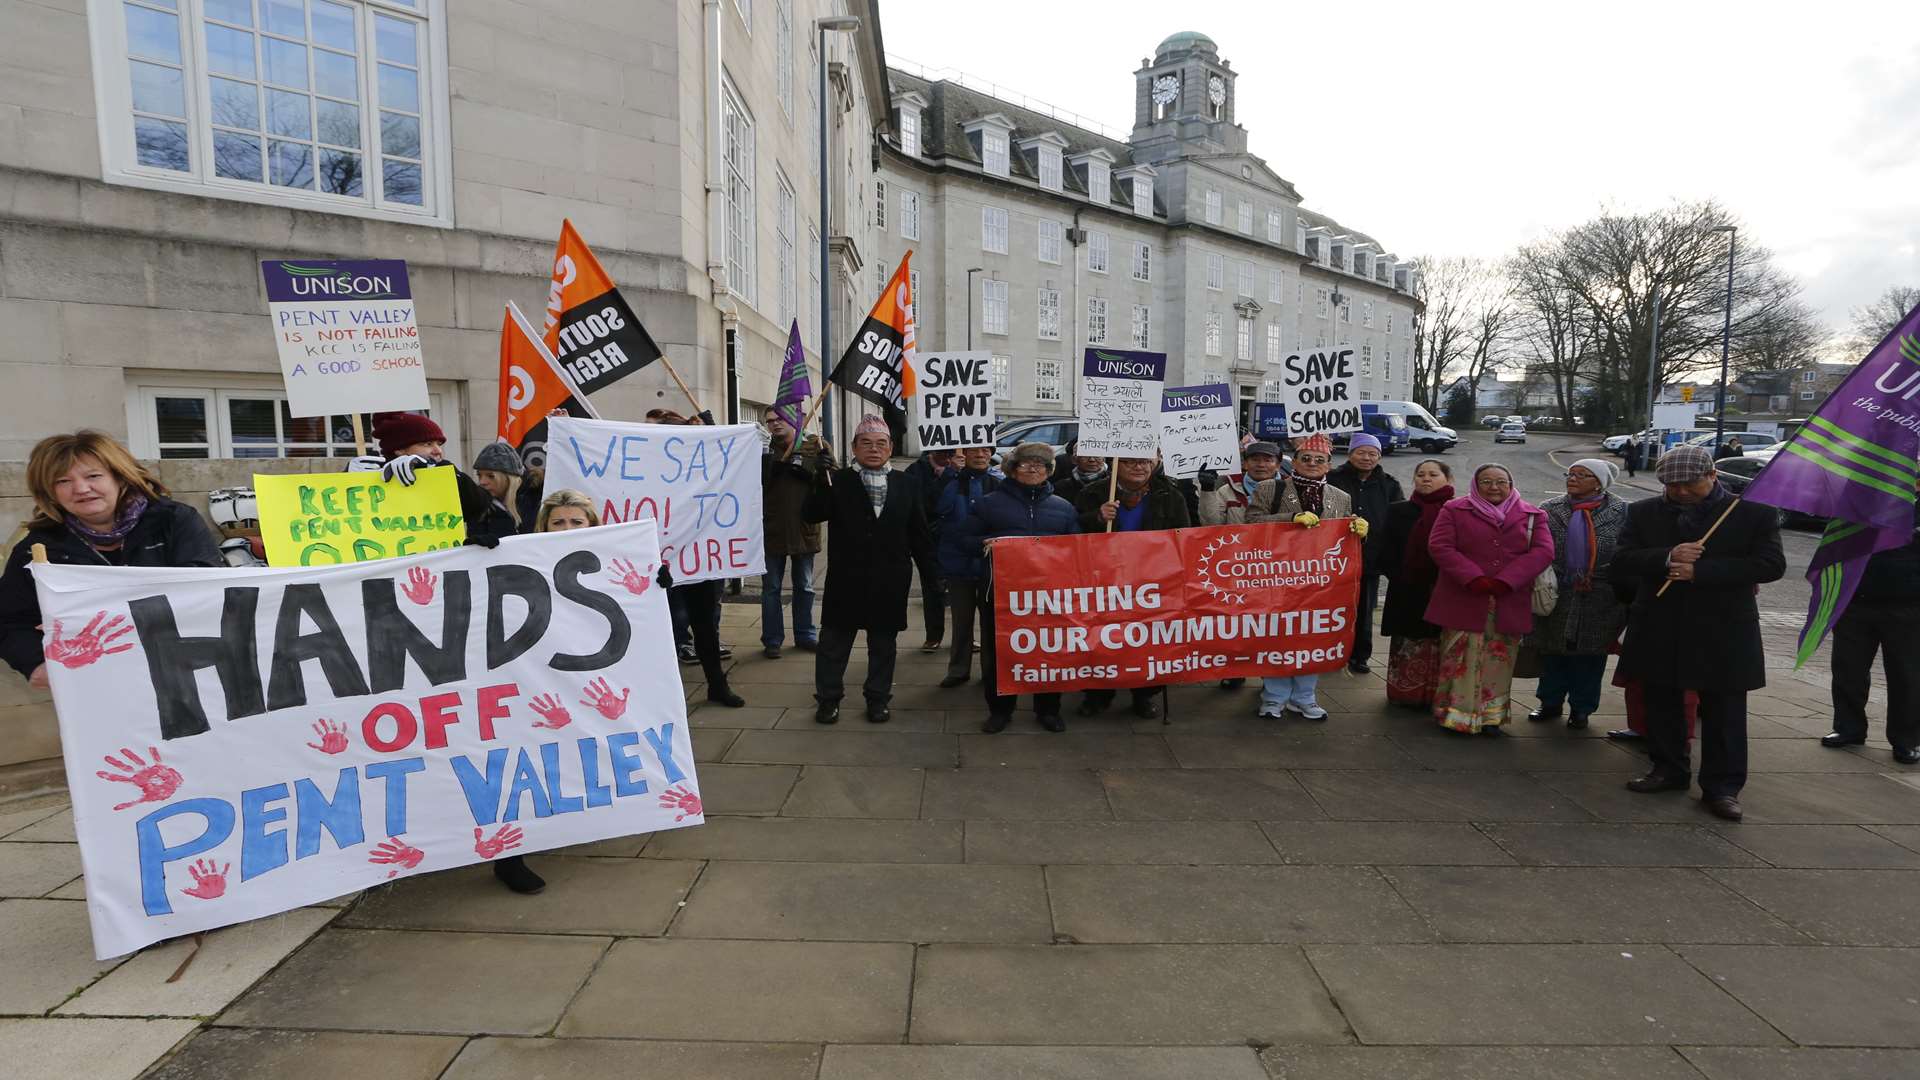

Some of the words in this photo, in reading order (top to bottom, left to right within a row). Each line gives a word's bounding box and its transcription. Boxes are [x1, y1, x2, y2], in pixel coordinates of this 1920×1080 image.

[292, 276, 391, 295] UNISON
[279, 310, 340, 327] PENT
[350, 308, 411, 324] VALLEY
[284, 331, 303, 343] IS
[318, 329, 357, 341] NOT
[365, 326, 417, 340] FAILING
[305, 344, 341, 357] KCC
[352, 343, 366, 353] IS
[374, 341, 420, 351] FAILING
[292, 364, 307, 377] A
[318, 360, 361, 375] GOOD
[372, 356, 421, 371] SCHOOL
[921, 357, 988, 388] SAVE
[1098, 361, 1155, 376] UNISON
[1285, 350, 1354, 386] SAVE
[1167, 393, 1221, 408] UNISON
[1298, 382, 1350, 404] OUR
[1852, 396, 1881, 413] the
[924, 392, 992, 419] PENT
[1179, 413, 1207, 421] SAVE
[1193, 422, 1231, 433] VALLEY
[1290, 406, 1362, 433] SCHOOL
[918, 423, 996, 447] VALLEY
[569, 436, 649, 481] WE
[660, 437, 736, 483] SAY
[1171, 453, 1233, 468] PETITION
[298, 485, 386, 516] KEEP
[602, 496, 670, 535] NO!
[693, 492, 740, 529] TO
[290, 516, 363, 542] PENT
[371, 511, 463, 532] VALLEY
[1215, 554, 1348, 579] Community
[1234, 549, 1272, 561] unite
[1236, 574, 1330, 590] membership
[1008, 583, 1162, 616] UNITING
[1009, 626, 1090, 654] OUR
[1100, 606, 1347, 650] COMMUNITIES
[128, 550, 631, 740] HANDS
[1011, 662, 1119, 683] fairness
[1147, 650, 1228, 681] justice
[1256, 641, 1345, 669] respect
[361, 683, 520, 753] OFF
[136, 758, 426, 916] PENT
[451, 722, 686, 827] VALLEY
